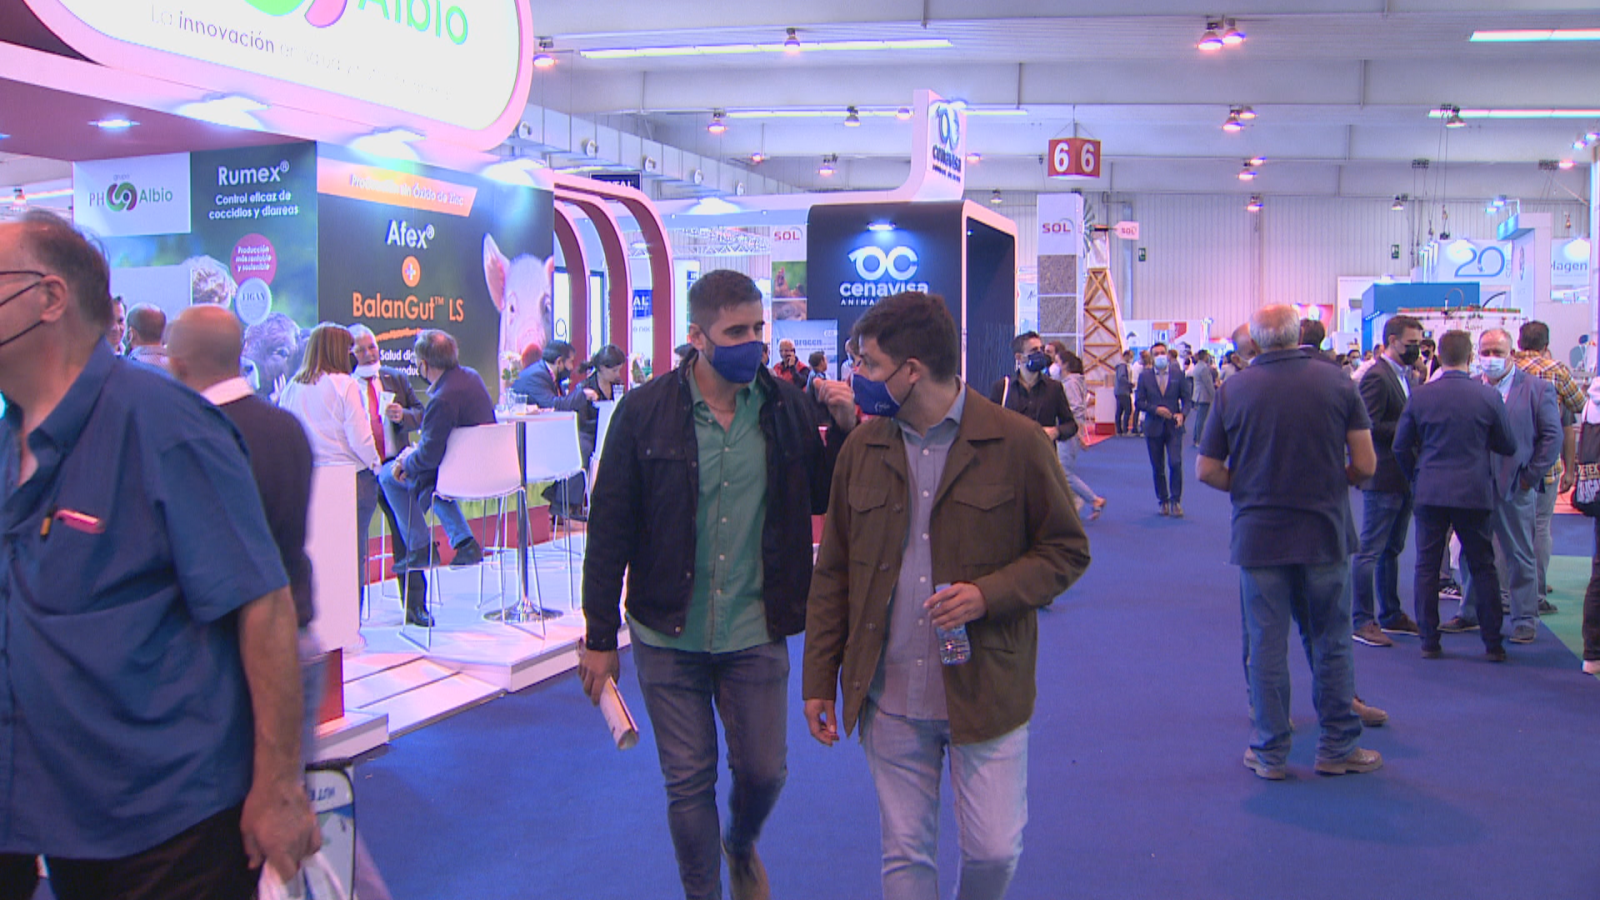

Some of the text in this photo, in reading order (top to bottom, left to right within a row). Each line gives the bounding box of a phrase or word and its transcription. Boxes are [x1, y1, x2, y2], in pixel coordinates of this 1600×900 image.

[179, 10, 275, 53] innovación
[1053, 142, 1070, 172] 6
[1080, 142, 1095, 172] 6
[89, 187, 174, 207] PH Albio
[215, 190, 292, 205] Control eficaz de
[208, 205, 299, 220] coccidios y diarreas
[774, 231, 800, 241] SOL
[1042, 223, 1071, 234] SOL
[1550, 260, 1588, 275] lagen
[840, 282, 929, 298] cenavisa
[449, 298, 465, 323] LS
[840, 299, 876, 307] ANIMA
[380, 350, 402, 361] Salud
